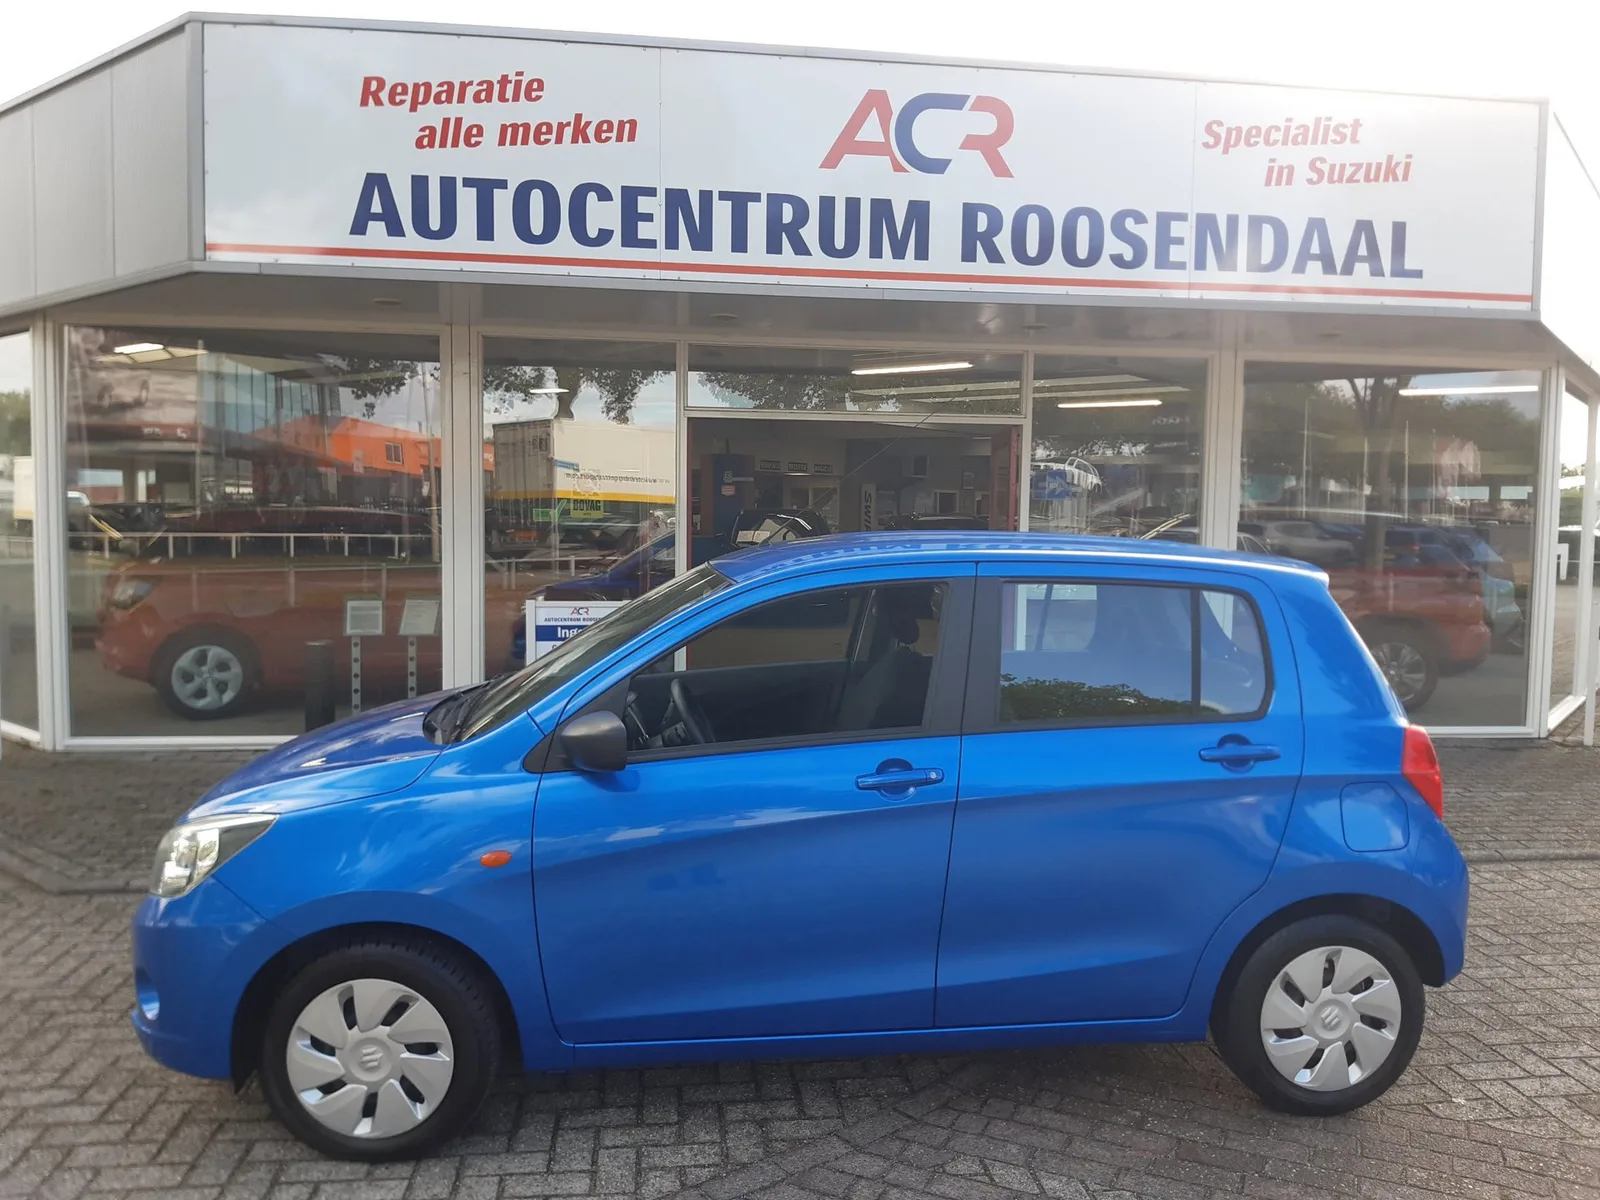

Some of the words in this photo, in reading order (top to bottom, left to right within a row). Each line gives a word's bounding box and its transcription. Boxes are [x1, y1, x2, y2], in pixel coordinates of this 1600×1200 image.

[360, 71, 545, 112] Reparatie
[414, 117, 485, 150] alle
[497, 113, 638, 147] merken
[818, 89, 1015, 178] ACR
[1202, 117, 1363, 153] Specialist
[1264, 157, 1295, 187] in
[1306, 153, 1414, 186] Suzuki
[350, 172, 931, 261] AUTOCENTRUM
[960, 202, 1424, 279] ROOSENDAAL
[573, 499, 601, 511] BOVAG
[570, 607, 590, 616] ACR
